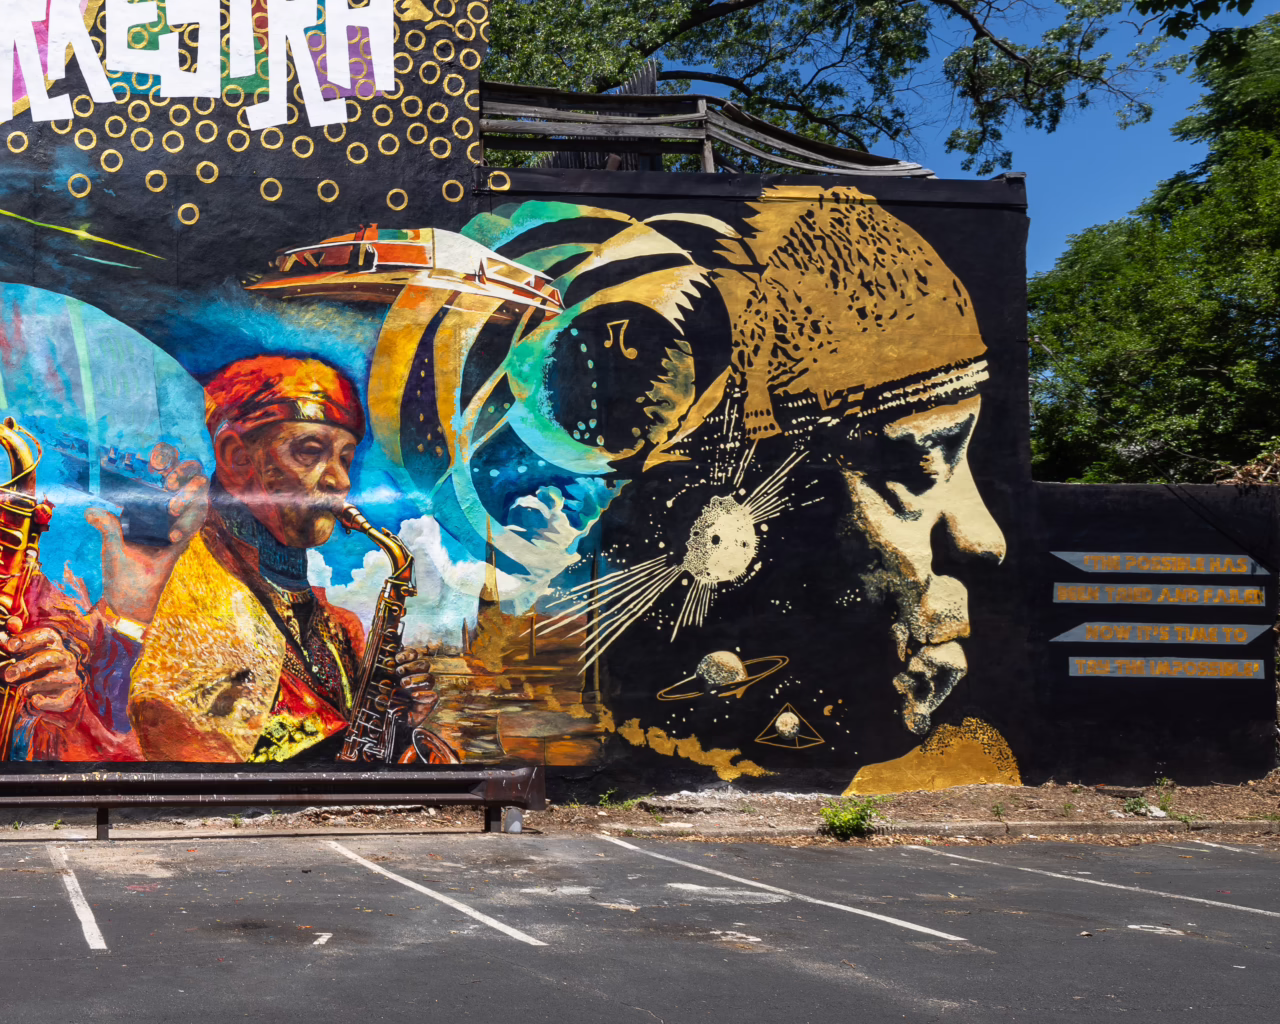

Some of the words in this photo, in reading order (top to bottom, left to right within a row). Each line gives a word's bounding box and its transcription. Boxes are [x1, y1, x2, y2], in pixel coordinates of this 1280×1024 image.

[1125, 555, 1205, 573] POSSIBLE
[1209, 557, 1249, 573] HAS
[1057, 585, 1100, 601] BEEN
[1105, 586, 1153, 602] TRIED
[1157, 587, 1200, 604] AND
[1085, 624, 1132, 641] NOW
[1136, 625, 1170, 641] IT'S
[1174, 626, 1218, 643] TIME
[1222, 627, 1249, 643] TO
[1075, 659, 1111, 675] TRY
[1114, 660, 1146, 676] THE
[312, 932, 334, 945] 7
